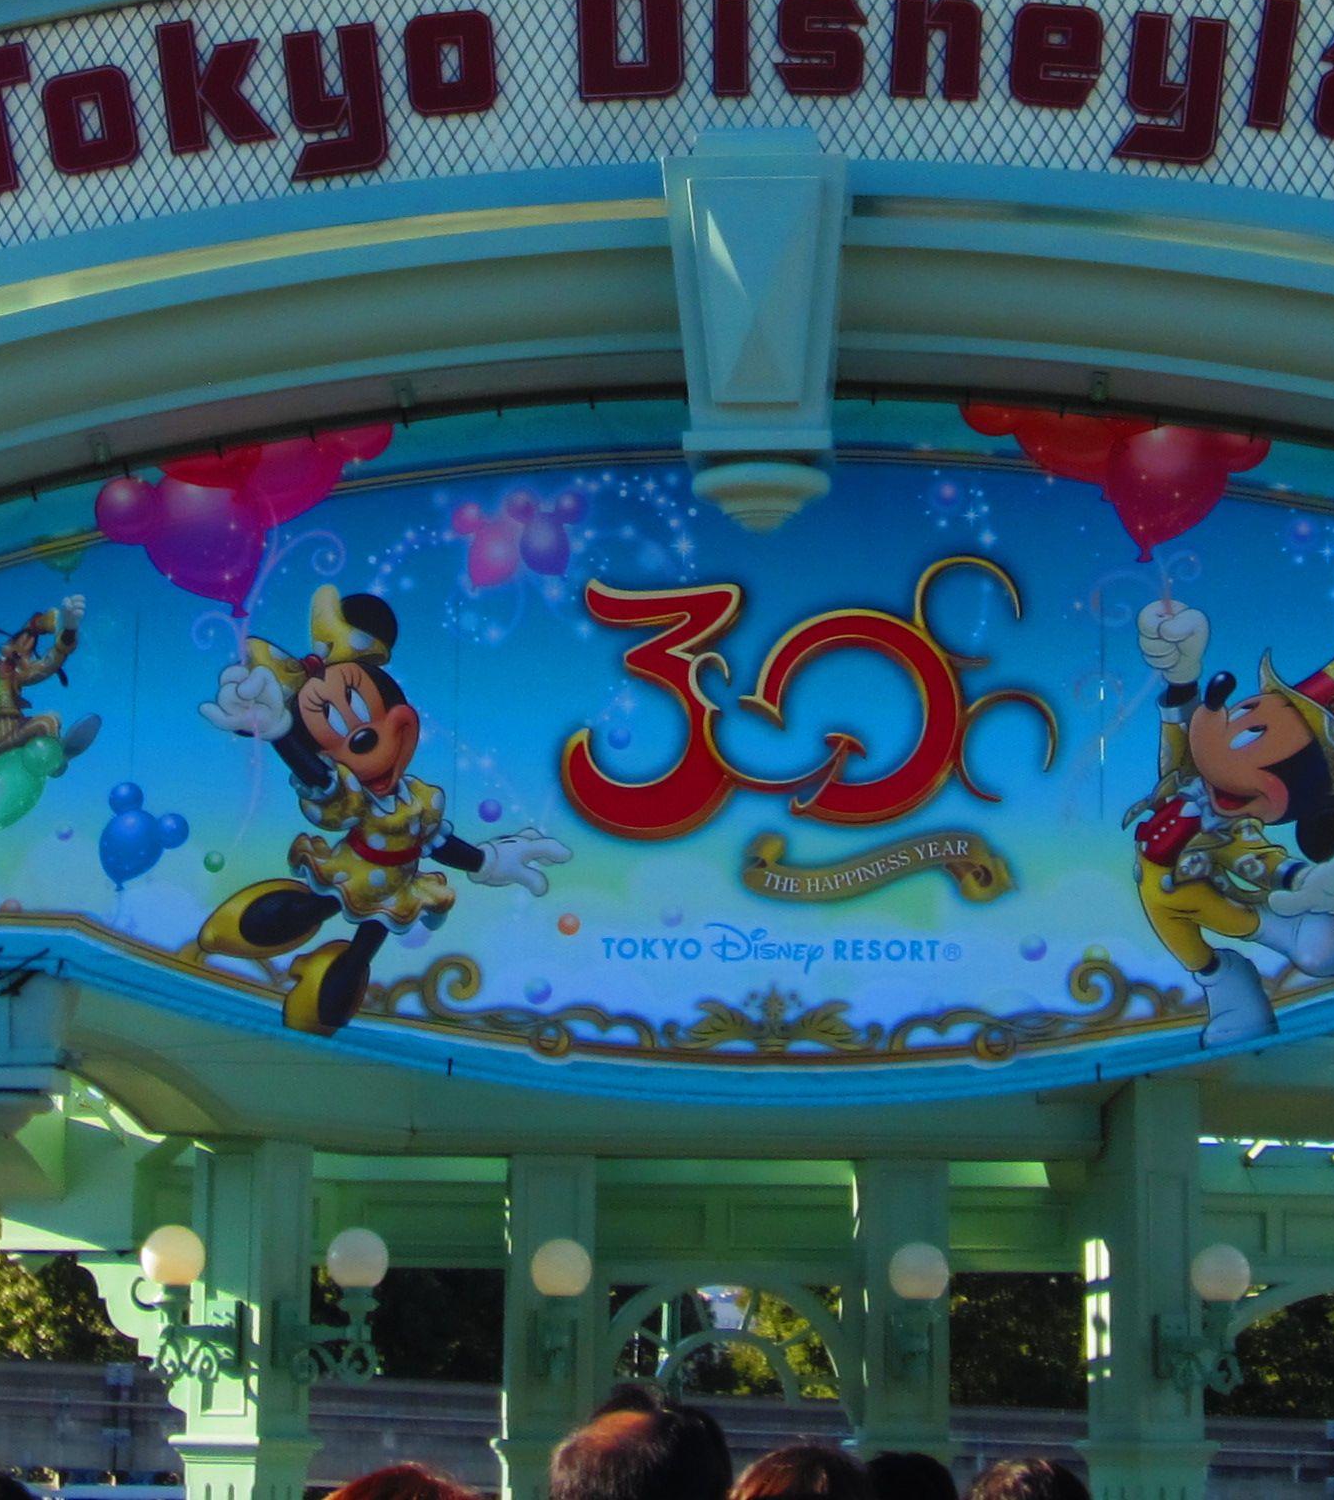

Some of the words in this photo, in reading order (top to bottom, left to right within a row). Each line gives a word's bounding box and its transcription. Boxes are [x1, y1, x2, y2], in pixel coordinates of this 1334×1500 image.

[764, 871, 801, 894] THE
[807, 849, 912, 894] HAPPINESS
[914, 839, 969, 861] YEAR
[602, 937, 702, 961] TOKYO
